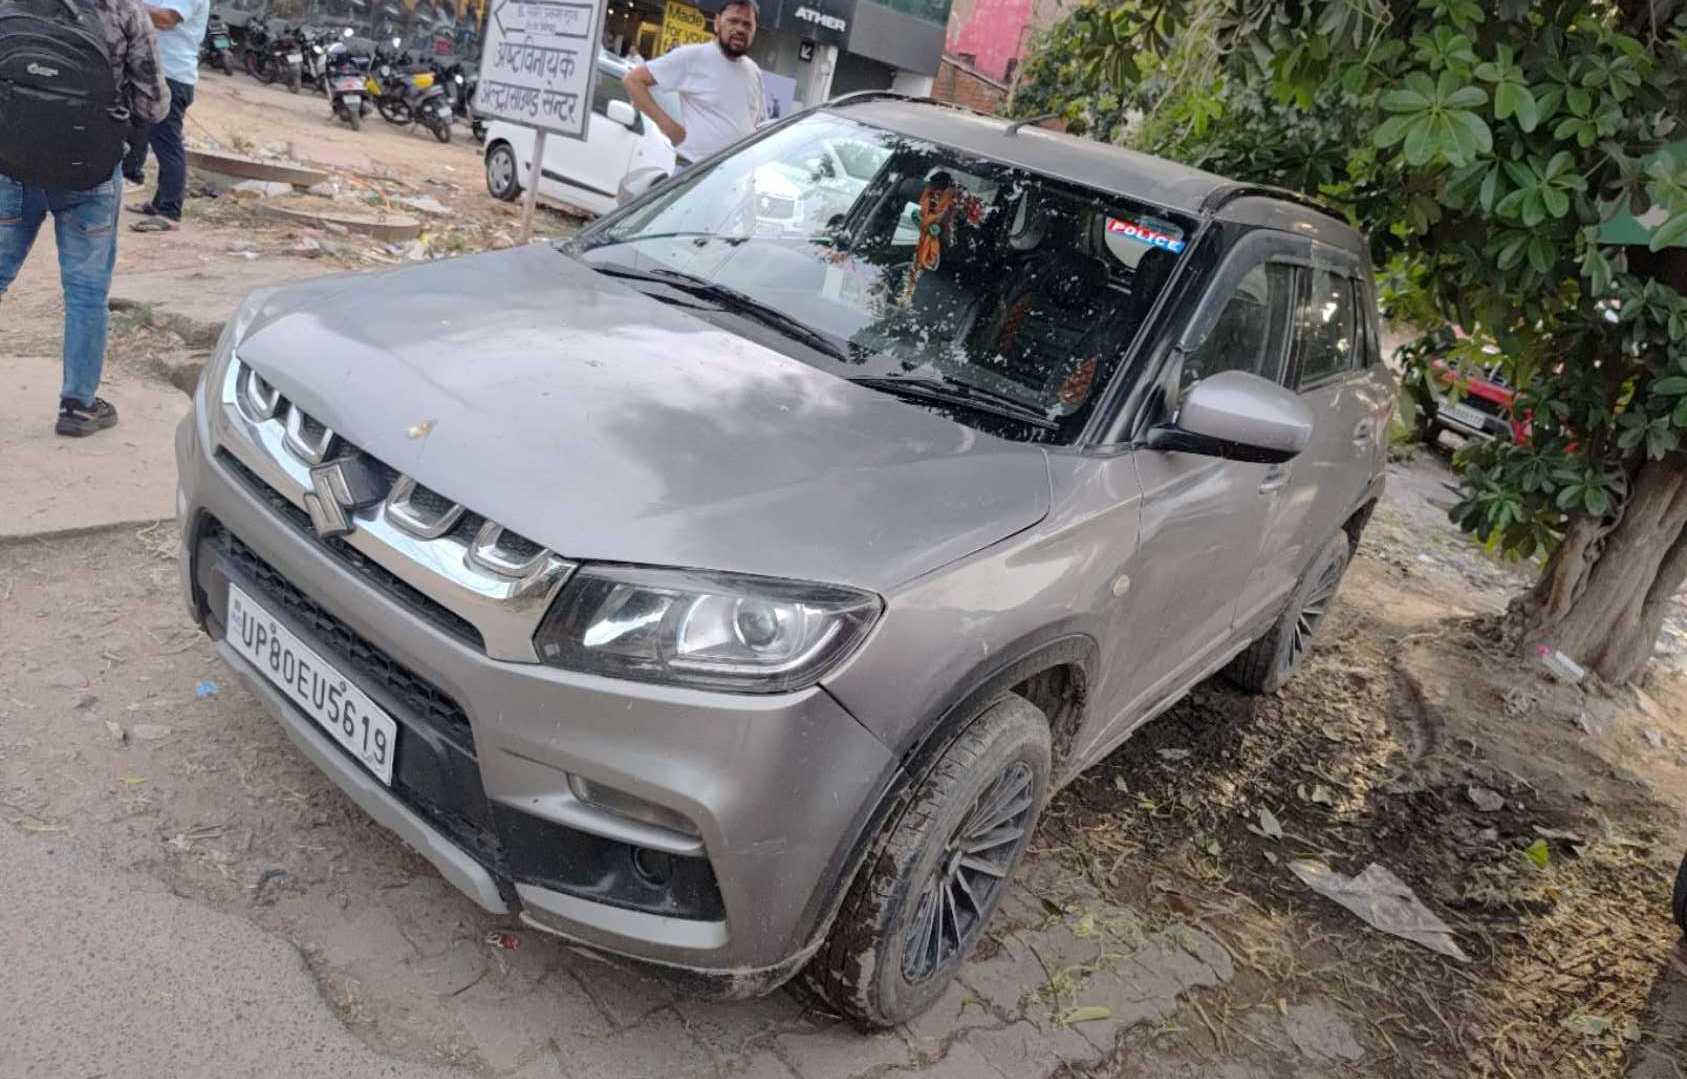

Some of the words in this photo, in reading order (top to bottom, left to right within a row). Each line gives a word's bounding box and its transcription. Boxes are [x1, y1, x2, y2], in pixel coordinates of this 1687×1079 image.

[794, 6, 847, 33] ATHER
[494, 35, 578, 80] अष्टविनायक
[1111, 220, 1182, 252] POLICE
[240, 609, 388, 767] UP80EU5619
